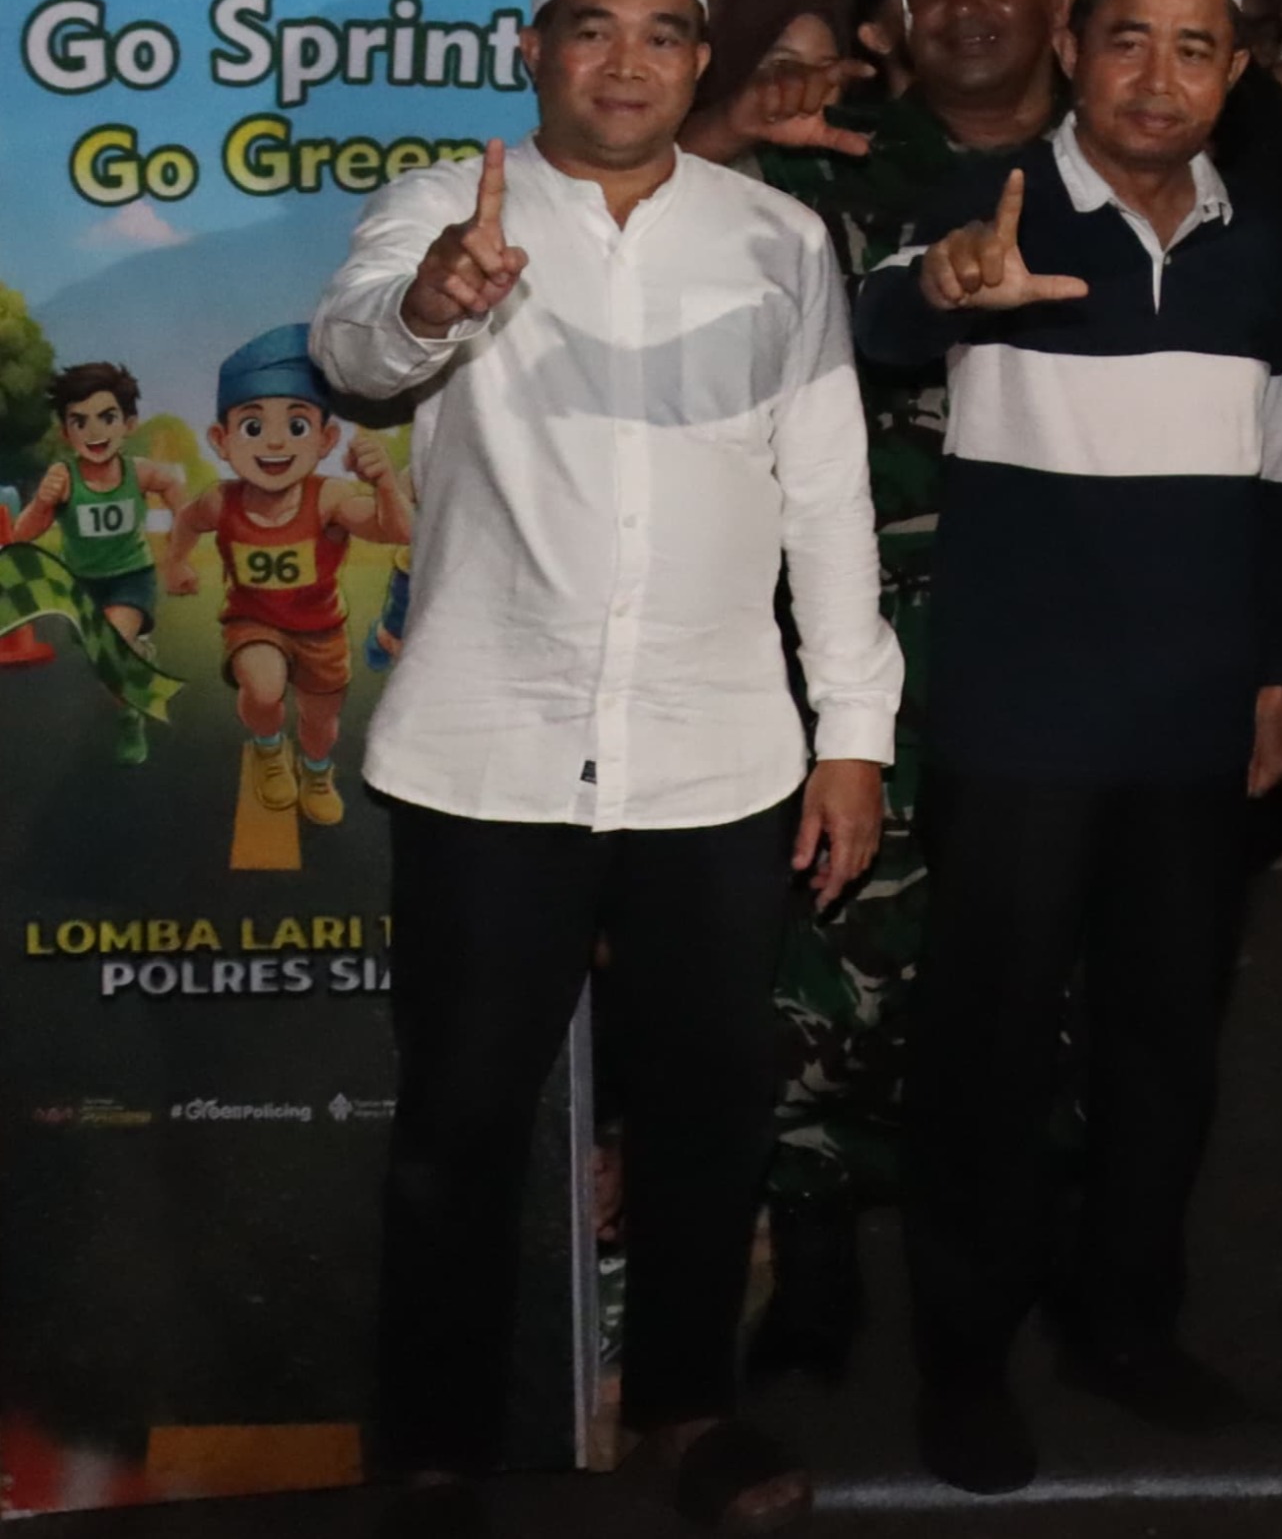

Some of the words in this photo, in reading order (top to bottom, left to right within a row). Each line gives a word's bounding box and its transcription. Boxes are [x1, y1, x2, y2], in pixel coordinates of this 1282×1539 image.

[69, 123, 199, 207] Go
[88, 503, 124, 534] 10
[246, 549, 301, 585] 96
[26, 918, 223, 955] LOMBA
[241, 915, 363, 950] LARI
[101, 957, 314, 996] POLRES
